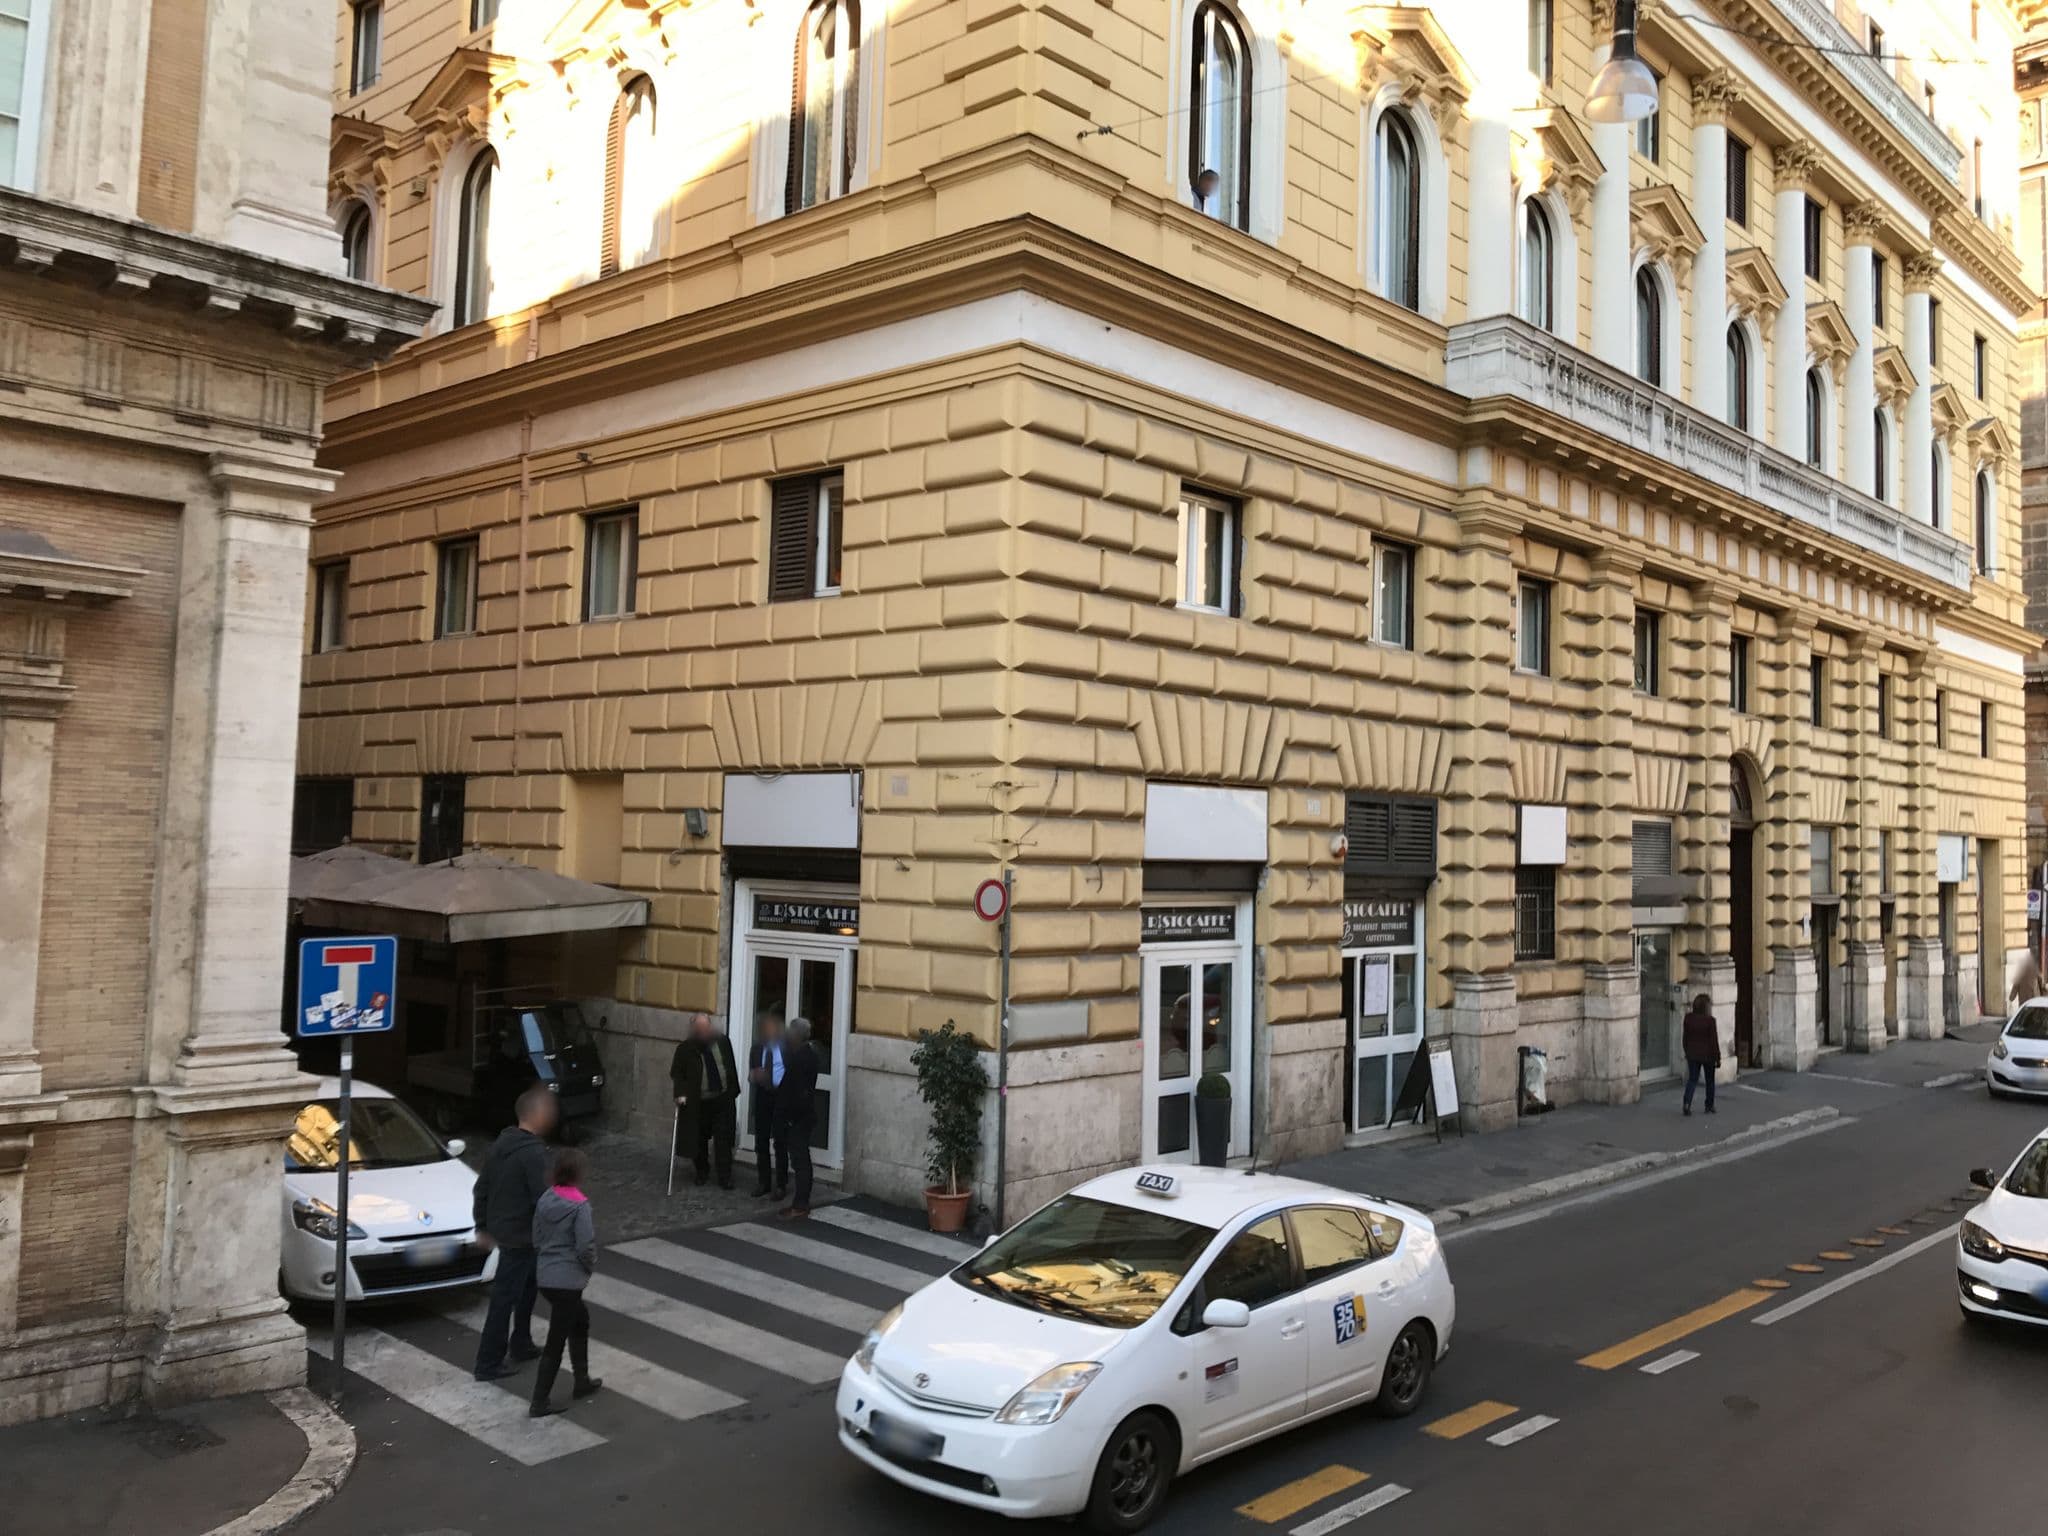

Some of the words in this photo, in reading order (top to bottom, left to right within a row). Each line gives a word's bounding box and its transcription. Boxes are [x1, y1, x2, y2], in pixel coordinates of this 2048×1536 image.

[1140, 1174, 1172, 1189] TAXI
[1336, 1302, 1354, 1323] 35
[1338, 1320, 1355, 1341] 70
